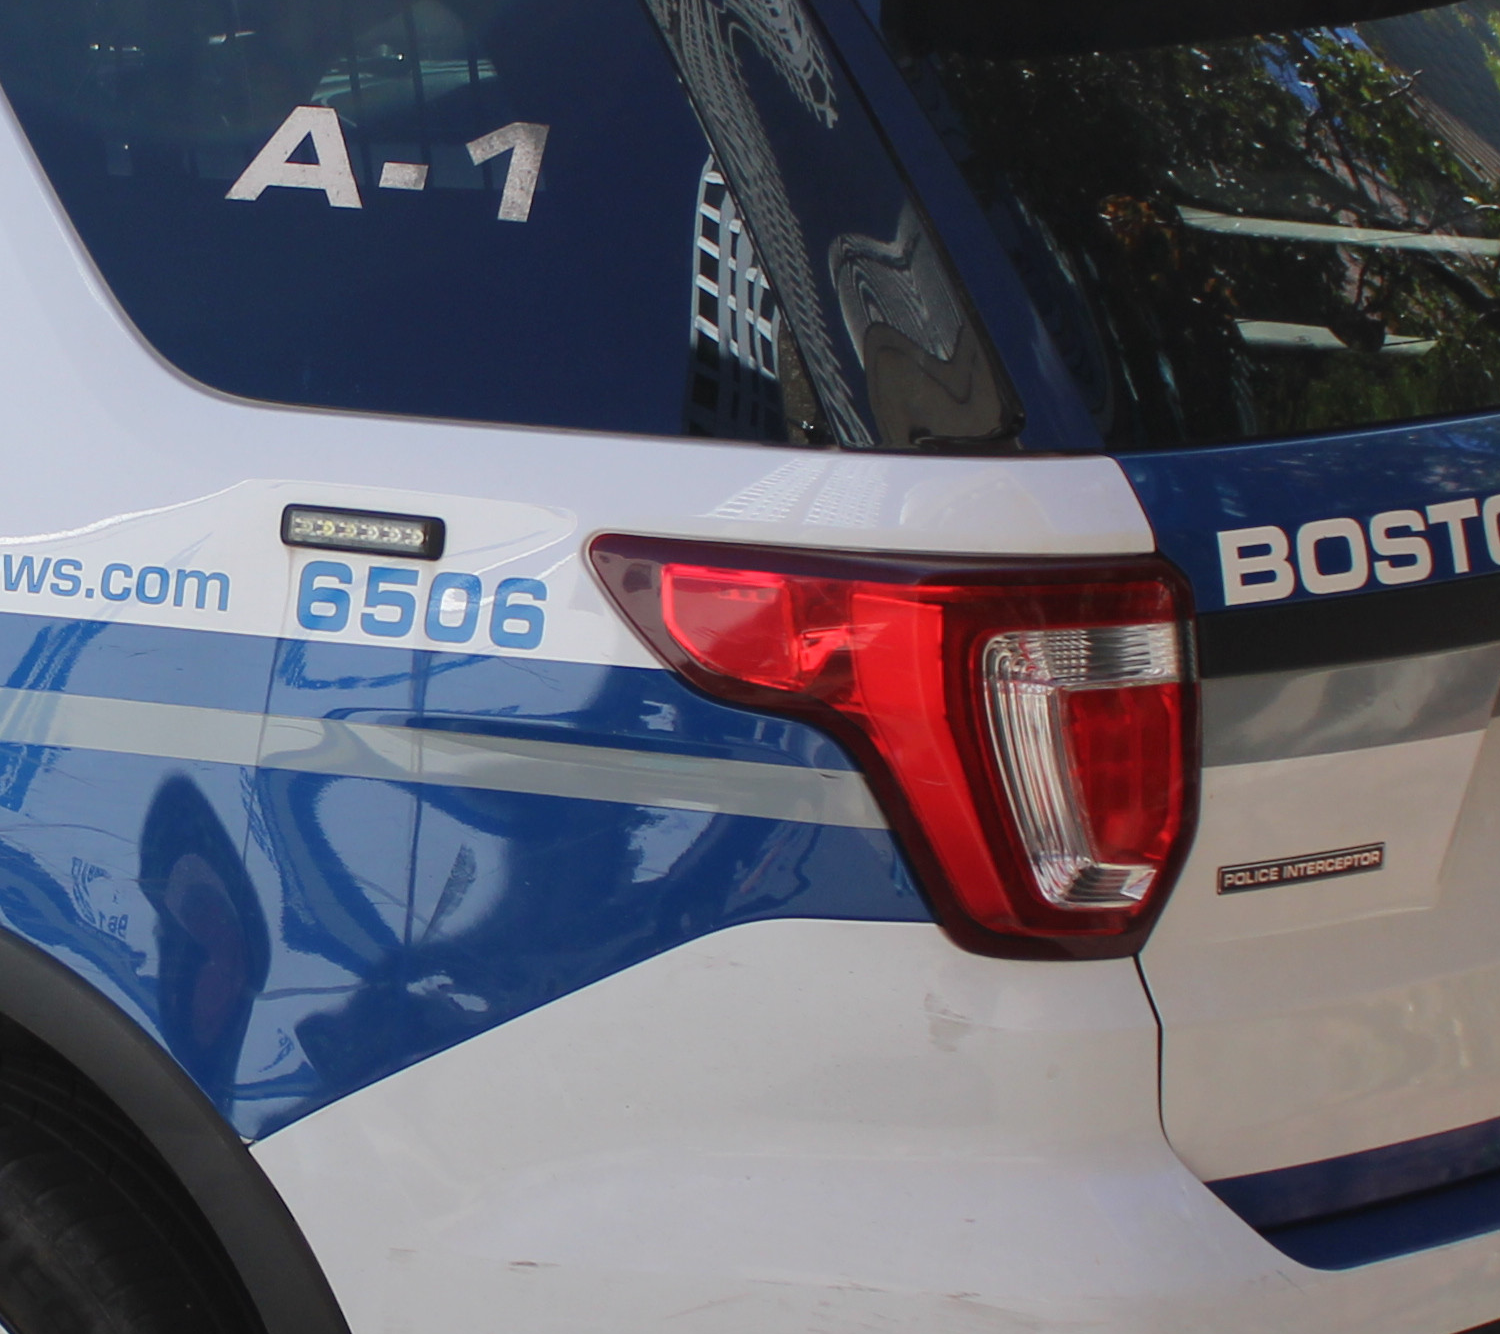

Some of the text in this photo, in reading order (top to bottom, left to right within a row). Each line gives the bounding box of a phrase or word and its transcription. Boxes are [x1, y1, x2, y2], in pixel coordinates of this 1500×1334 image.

[224, 105, 550, 223] A-1
[298, 560, 549, 650] 6506
[1224, 850, 1381, 888] POLICE INTERCEPTOR
